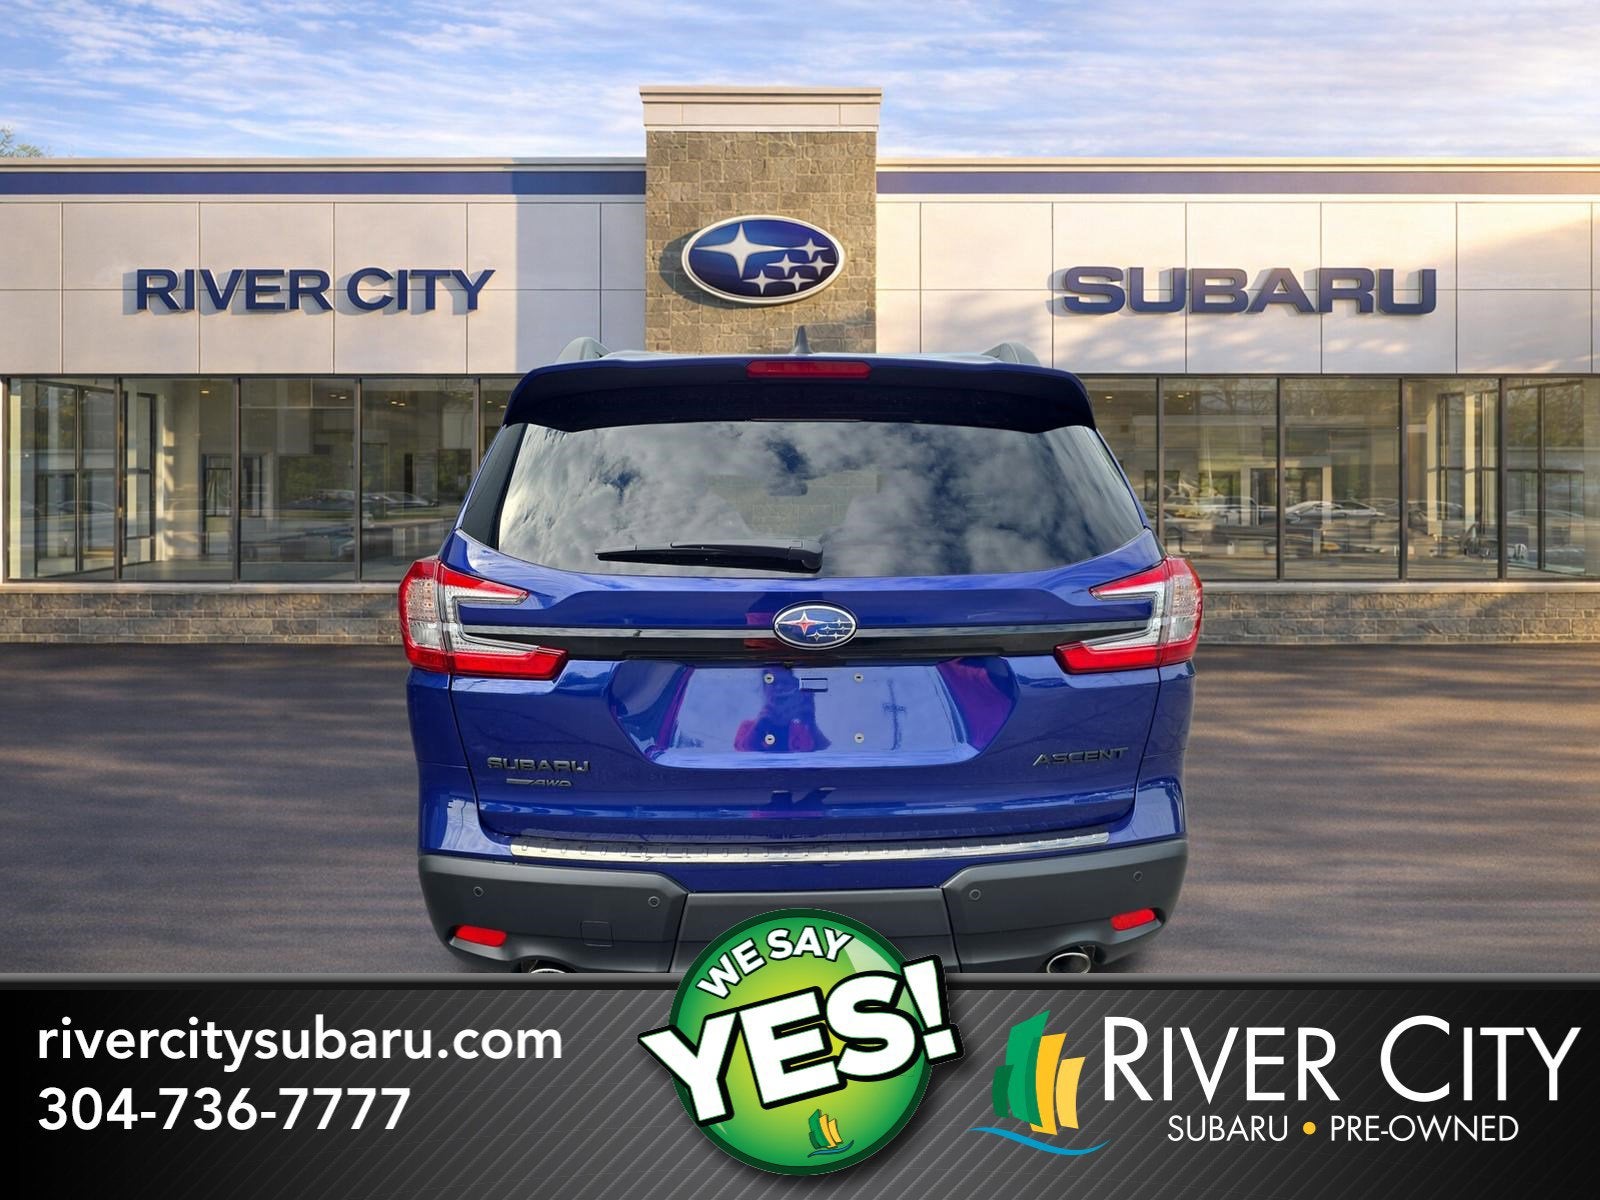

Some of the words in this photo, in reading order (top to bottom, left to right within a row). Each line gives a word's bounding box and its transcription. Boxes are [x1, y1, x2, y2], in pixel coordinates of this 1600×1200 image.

[136, 269, 334, 311] RIVER
[346, 267, 496, 312] CITY
[1063, 266, 1437, 315] SUBARU
[487, 756, 590, 773] SUBARU
[1032, 746, 1129, 767] ASCENT
